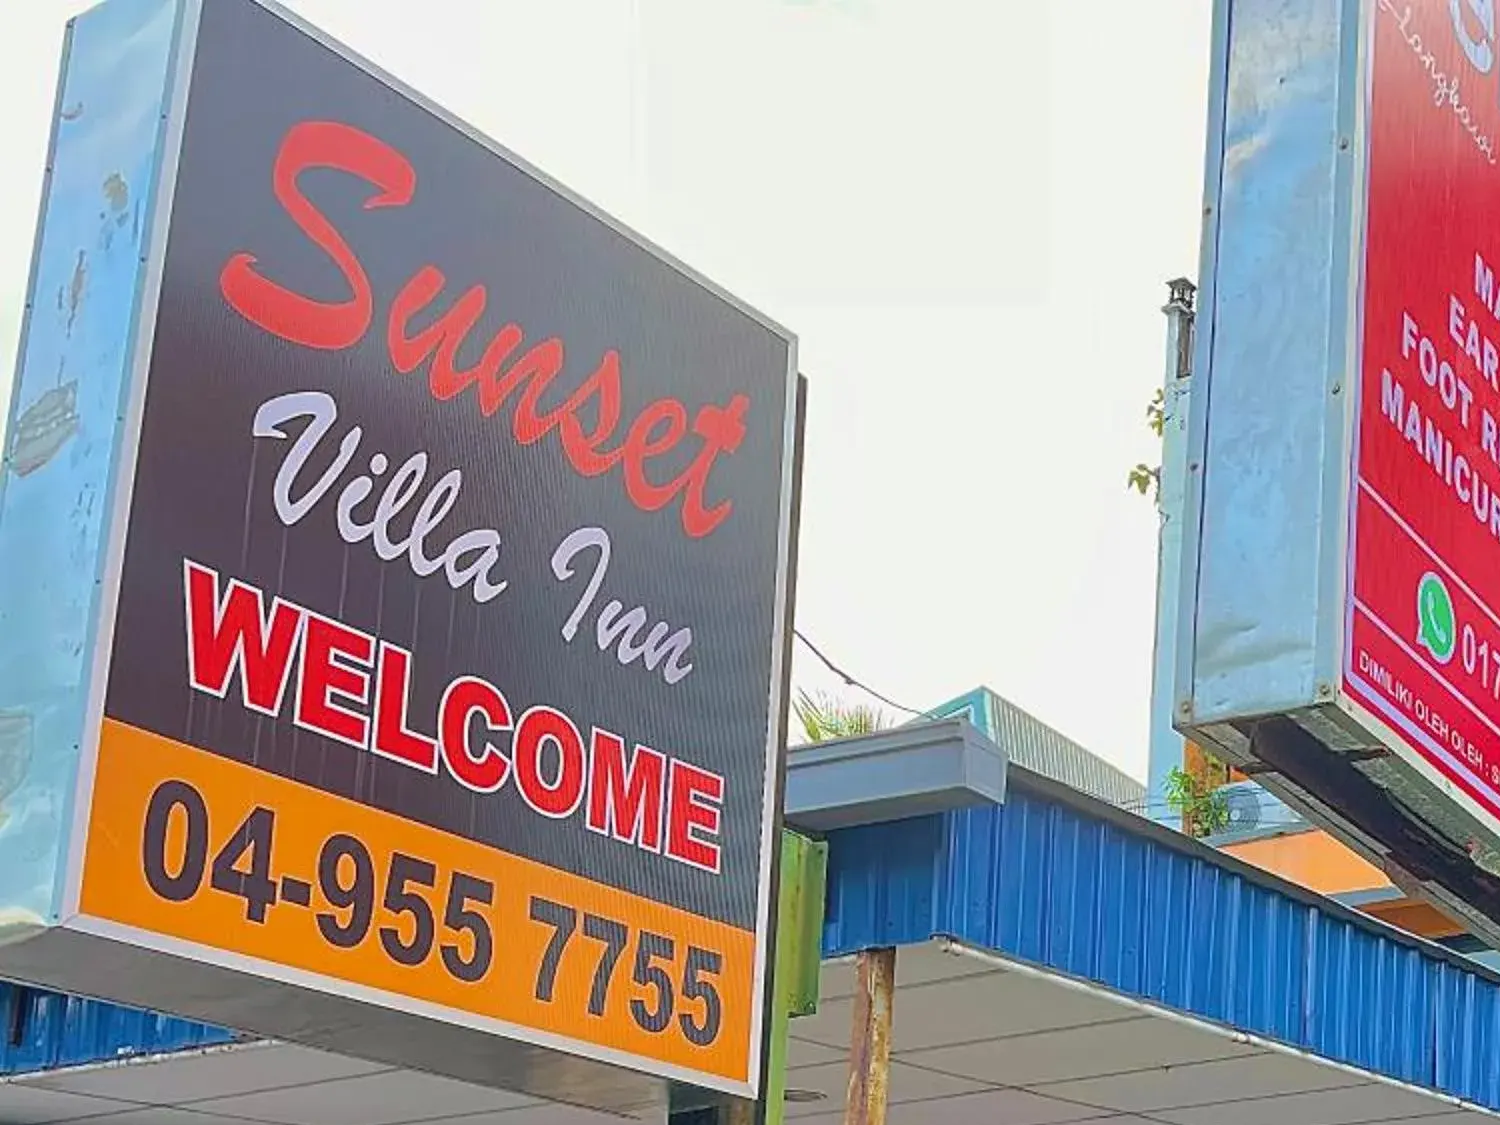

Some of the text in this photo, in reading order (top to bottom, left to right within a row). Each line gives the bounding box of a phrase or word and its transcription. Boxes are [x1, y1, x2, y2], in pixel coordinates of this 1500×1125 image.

[220, 120, 750, 537] Sunset
[1402, 311, 1473, 429] FOOT
[1450, 293, 1499, 392] EAR
[253, 390, 693, 684] Villa Inn
[183, 560, 726, 873] WELCOME
[1358, 650, 1413, 708] DIMILIKI
[1415, 699, 1449, 745] OLEH
[1451, 730, 1483, 770] OLEH
[141, 779, 724, 1047] 04-955 7755
